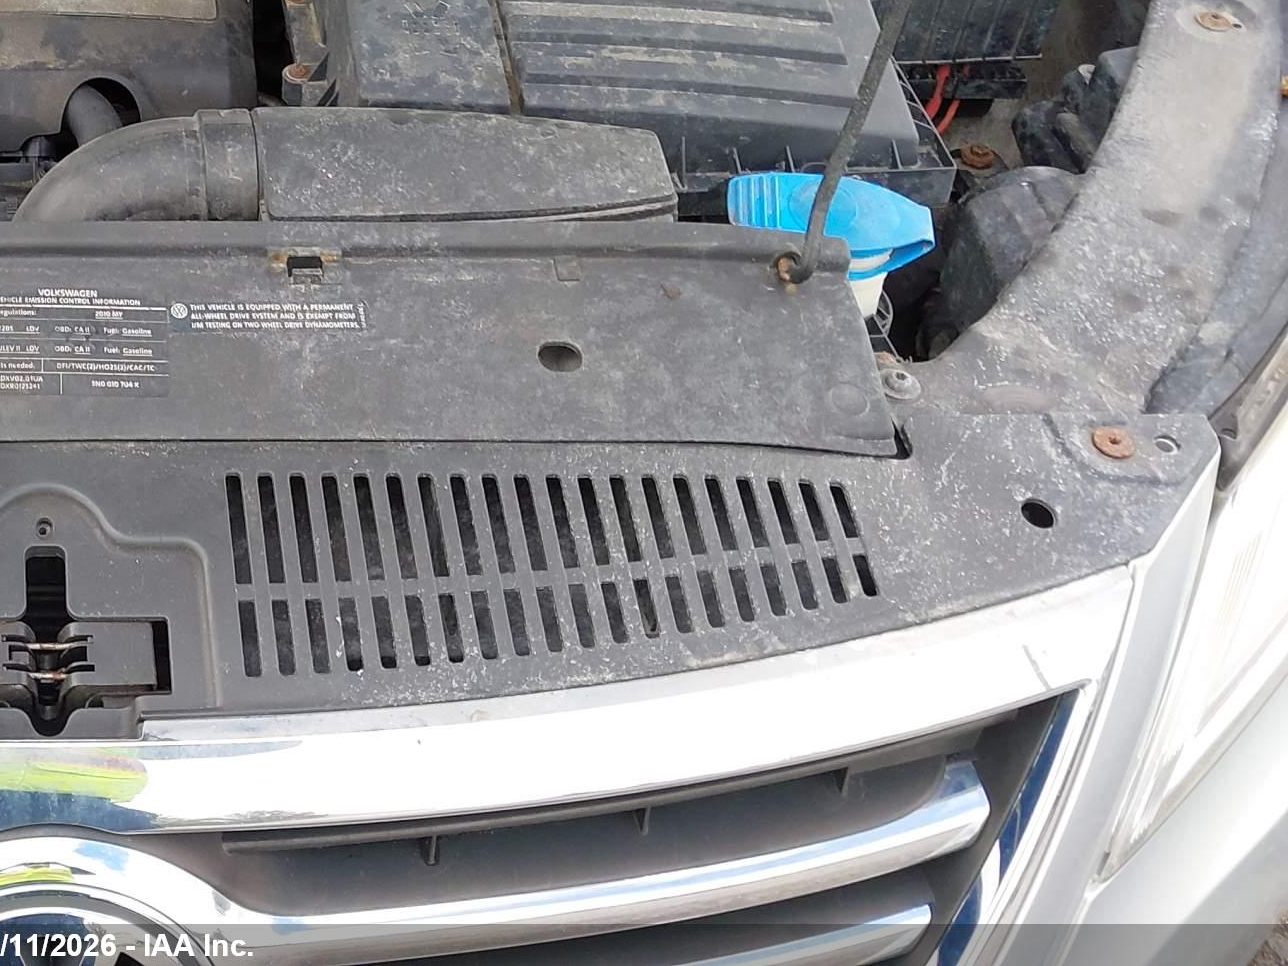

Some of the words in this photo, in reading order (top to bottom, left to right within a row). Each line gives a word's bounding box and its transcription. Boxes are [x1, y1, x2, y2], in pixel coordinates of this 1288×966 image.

[38, 289, 98, 298] VOLKSWAGEN
[122, 327, 152, 335] Gasoline
[122, 347, 152, 355] Gasoline
